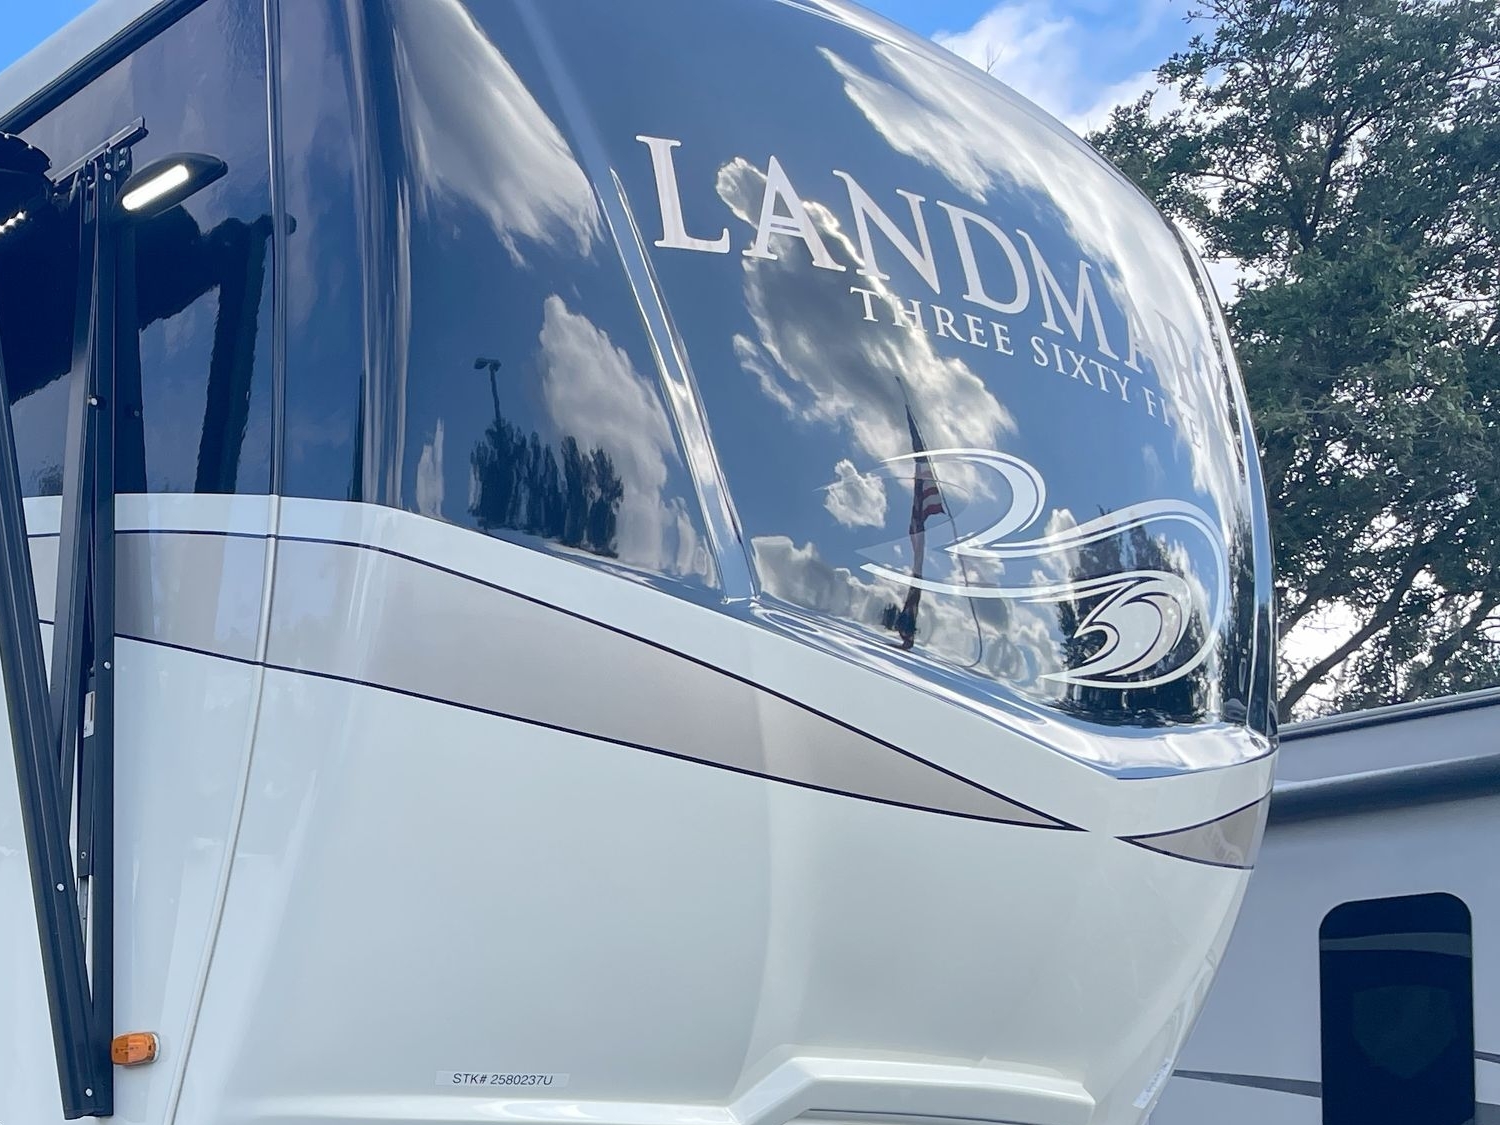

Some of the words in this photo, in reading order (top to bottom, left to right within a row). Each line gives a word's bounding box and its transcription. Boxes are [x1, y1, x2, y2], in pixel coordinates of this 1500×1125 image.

[636, 135, 1245, 464] LANDMARK
[850, 286, 1014, 356] THREE
[1030, 335, 1132, 404] SIXTY
[452, 1072, 487, 1085] STK#
[490, 1074, 553, 1086] 2580237U
